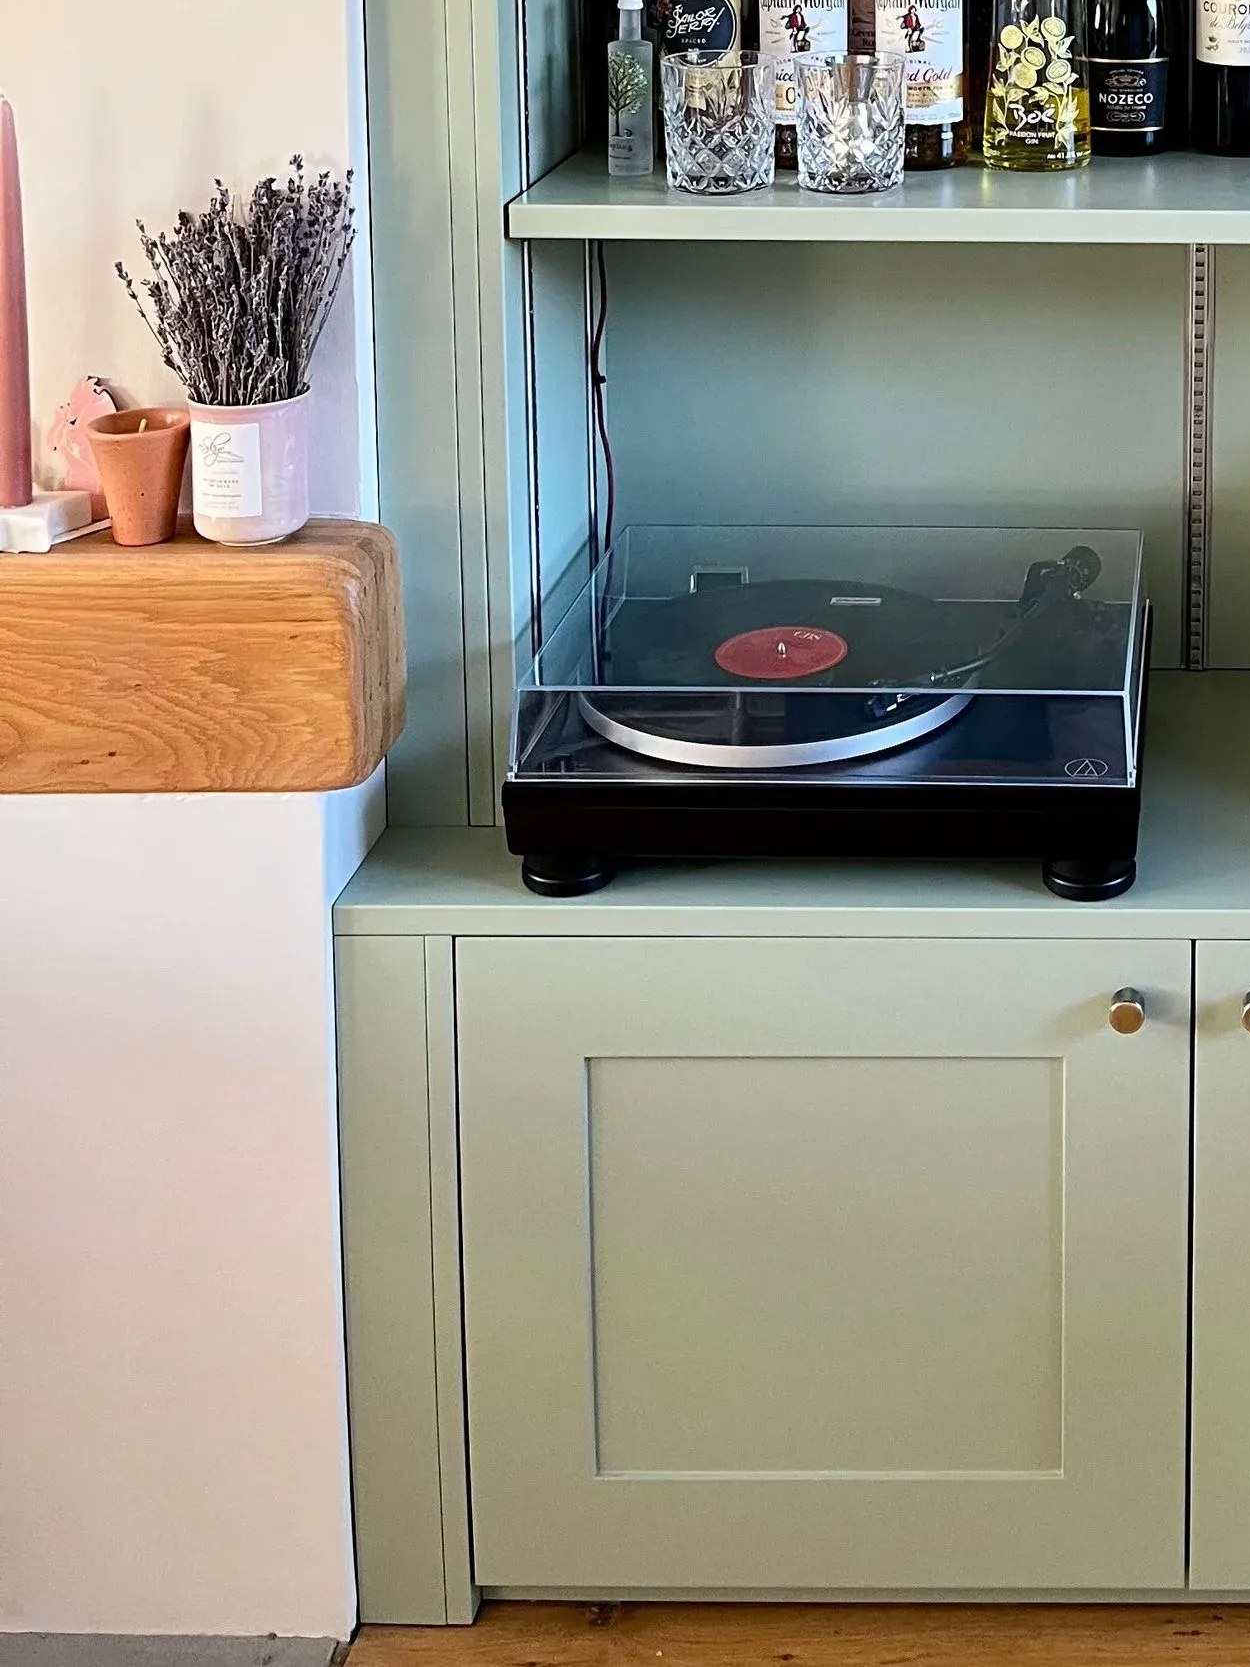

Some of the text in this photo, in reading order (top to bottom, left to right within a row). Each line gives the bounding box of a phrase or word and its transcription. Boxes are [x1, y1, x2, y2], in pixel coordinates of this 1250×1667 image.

[922, 67, 953, 83] Gold
[1098, 92, 1154, 105] NOZECO
[1009, 131, 1055, 139] PASSION FRUIT
